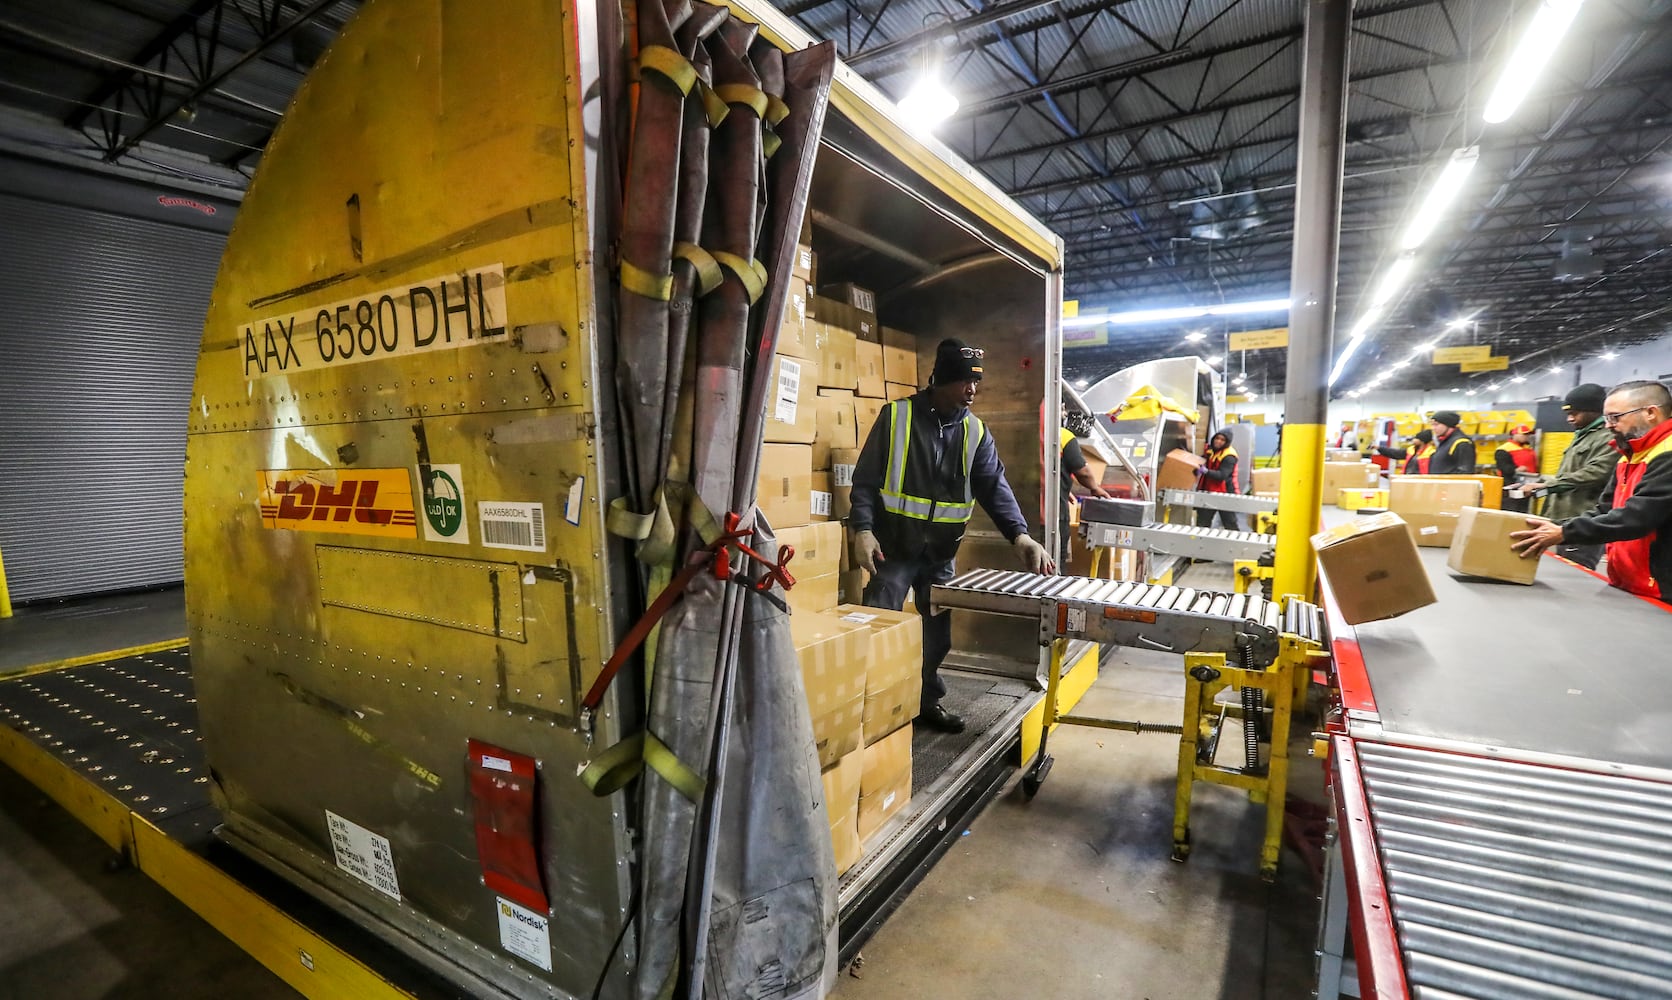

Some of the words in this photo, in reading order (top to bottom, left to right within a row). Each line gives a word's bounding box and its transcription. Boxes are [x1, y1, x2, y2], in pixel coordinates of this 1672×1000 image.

[245, 316, 301, 376] AAX
[315, 295, 398, 363] 6580
[408, 273, 505, 347] DHL
[274, 480, 394, 525] DHL
[445, 505, 457, 516] OK
[484, 508, 528, 518] AAX6580DHL
[512, 908, 545, 932] Nordisk
